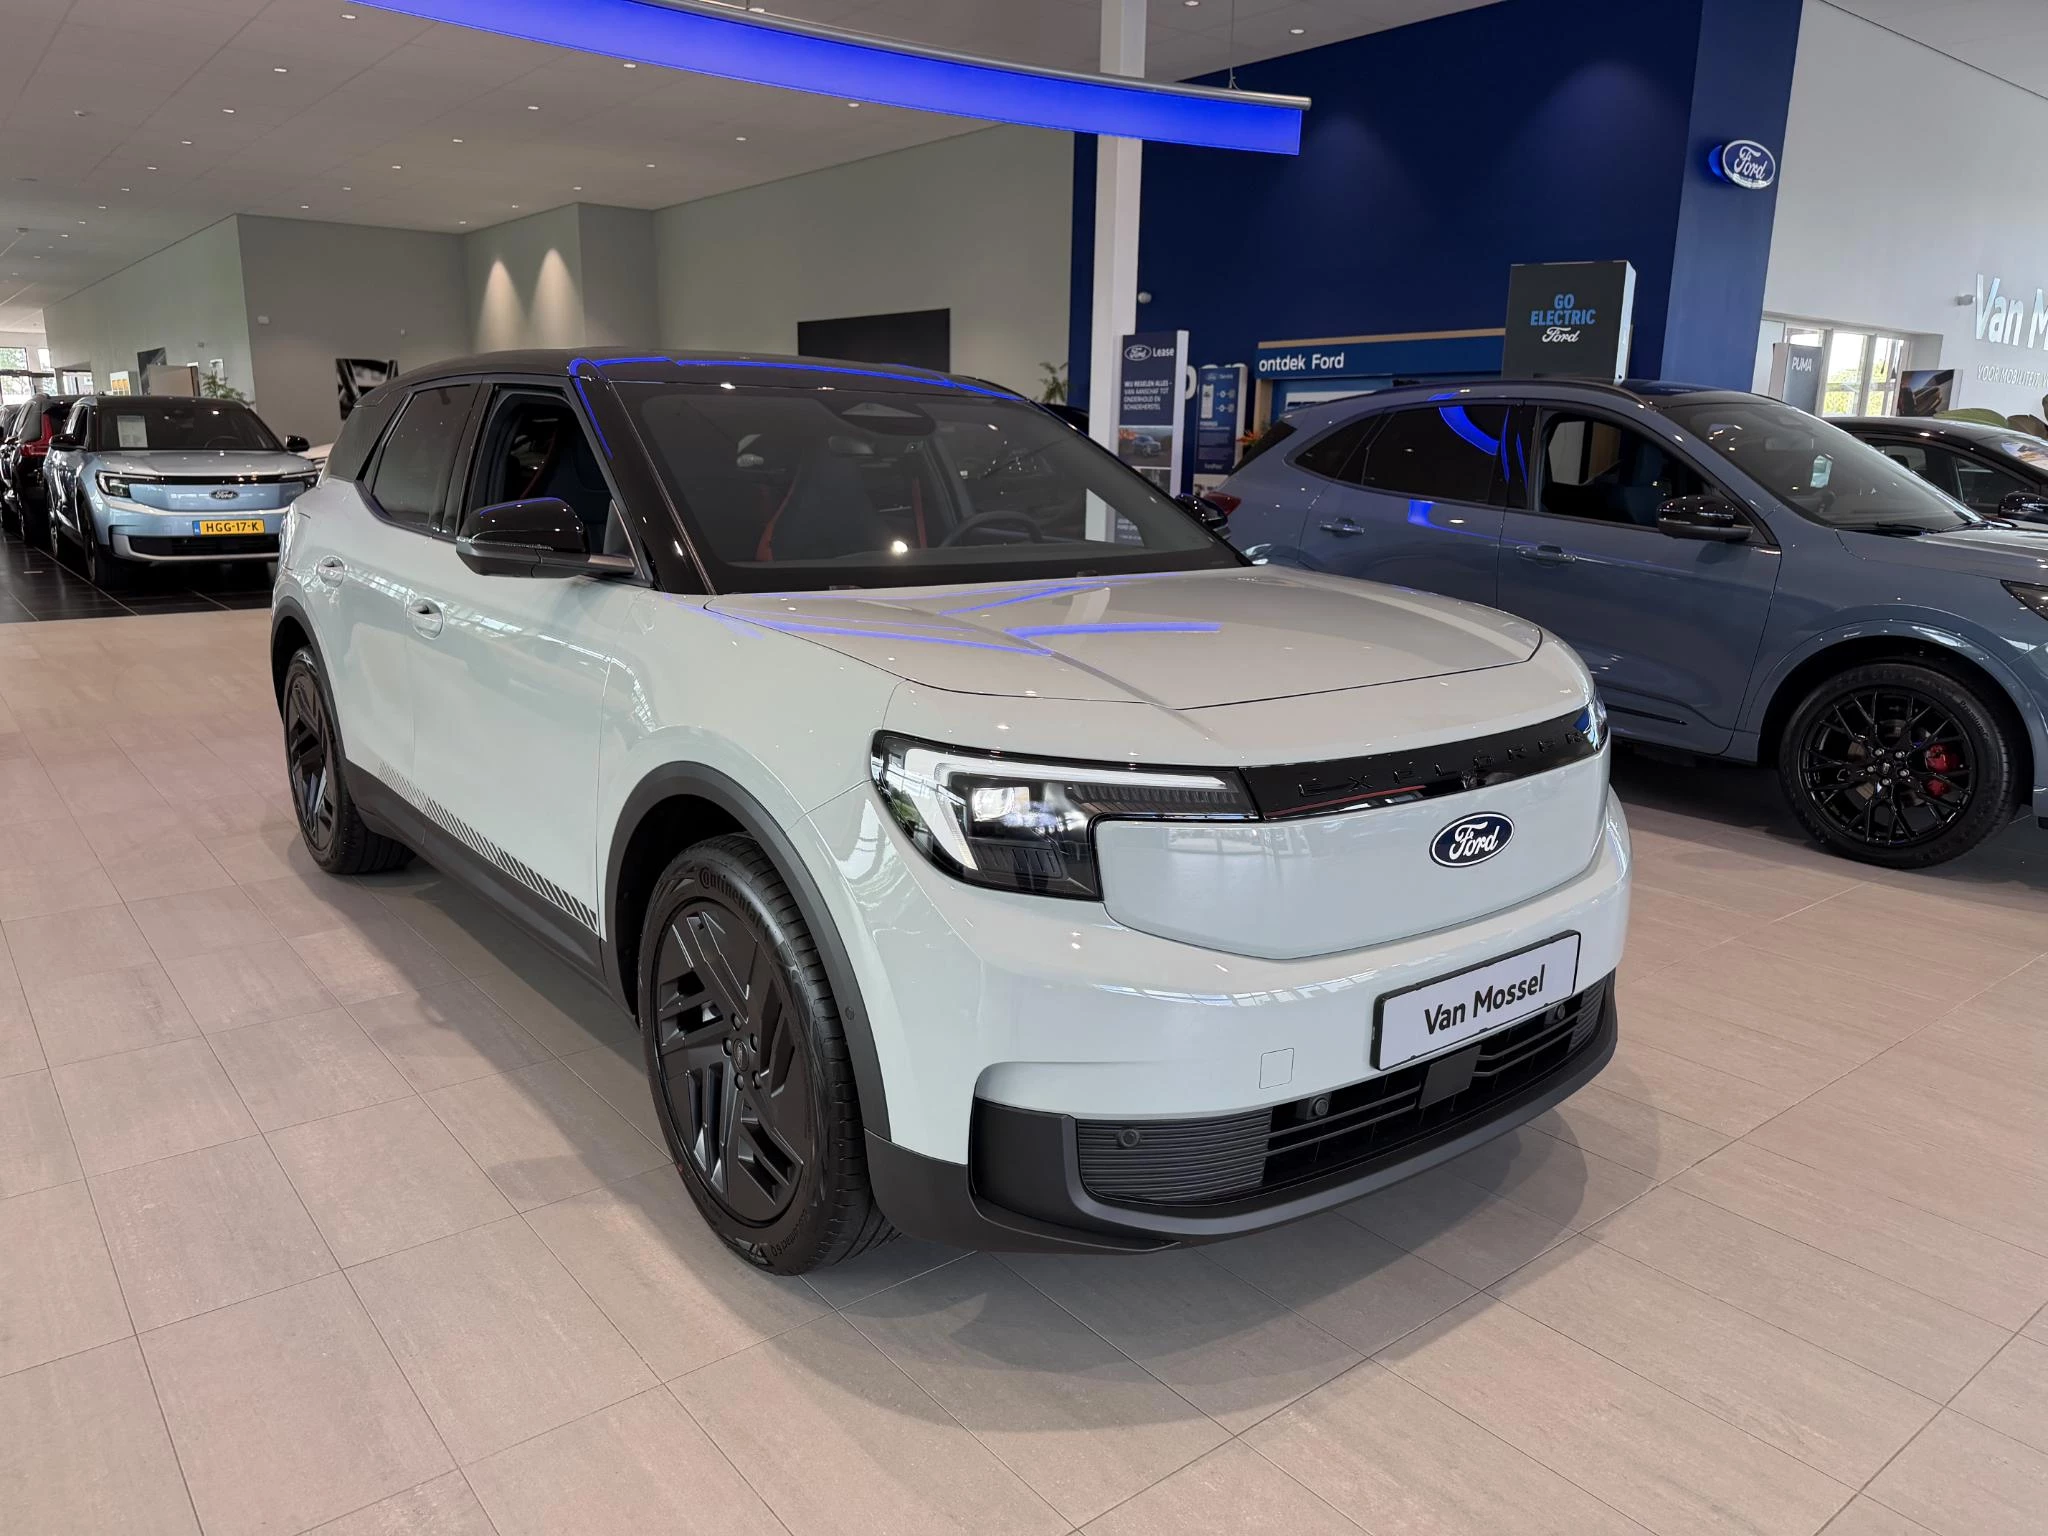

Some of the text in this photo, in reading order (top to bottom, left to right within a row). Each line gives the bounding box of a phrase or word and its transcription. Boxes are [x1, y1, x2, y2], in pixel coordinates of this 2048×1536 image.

[1733, 145, 1769, 180] Ford
[1553, 293, 1576, 310] GO
[1975, 272, 2024, 346] Van
[1530, 309, 1597, 327] ELECTRIC
[1542, 326, 1581, 343] Ford
[1152, 347, 1175, 358] Lease
[1258, 351, 1345, 372] ontdek Ford
[1791, 356, 1813, 373] PUMA
[215, 489, 234, 499] Ford
[206, 521, 259, 533] HGG-17-K
[1448, 820, 1501, 861] Ford
[1424, 963, 1546, 1036] Van Mossel
